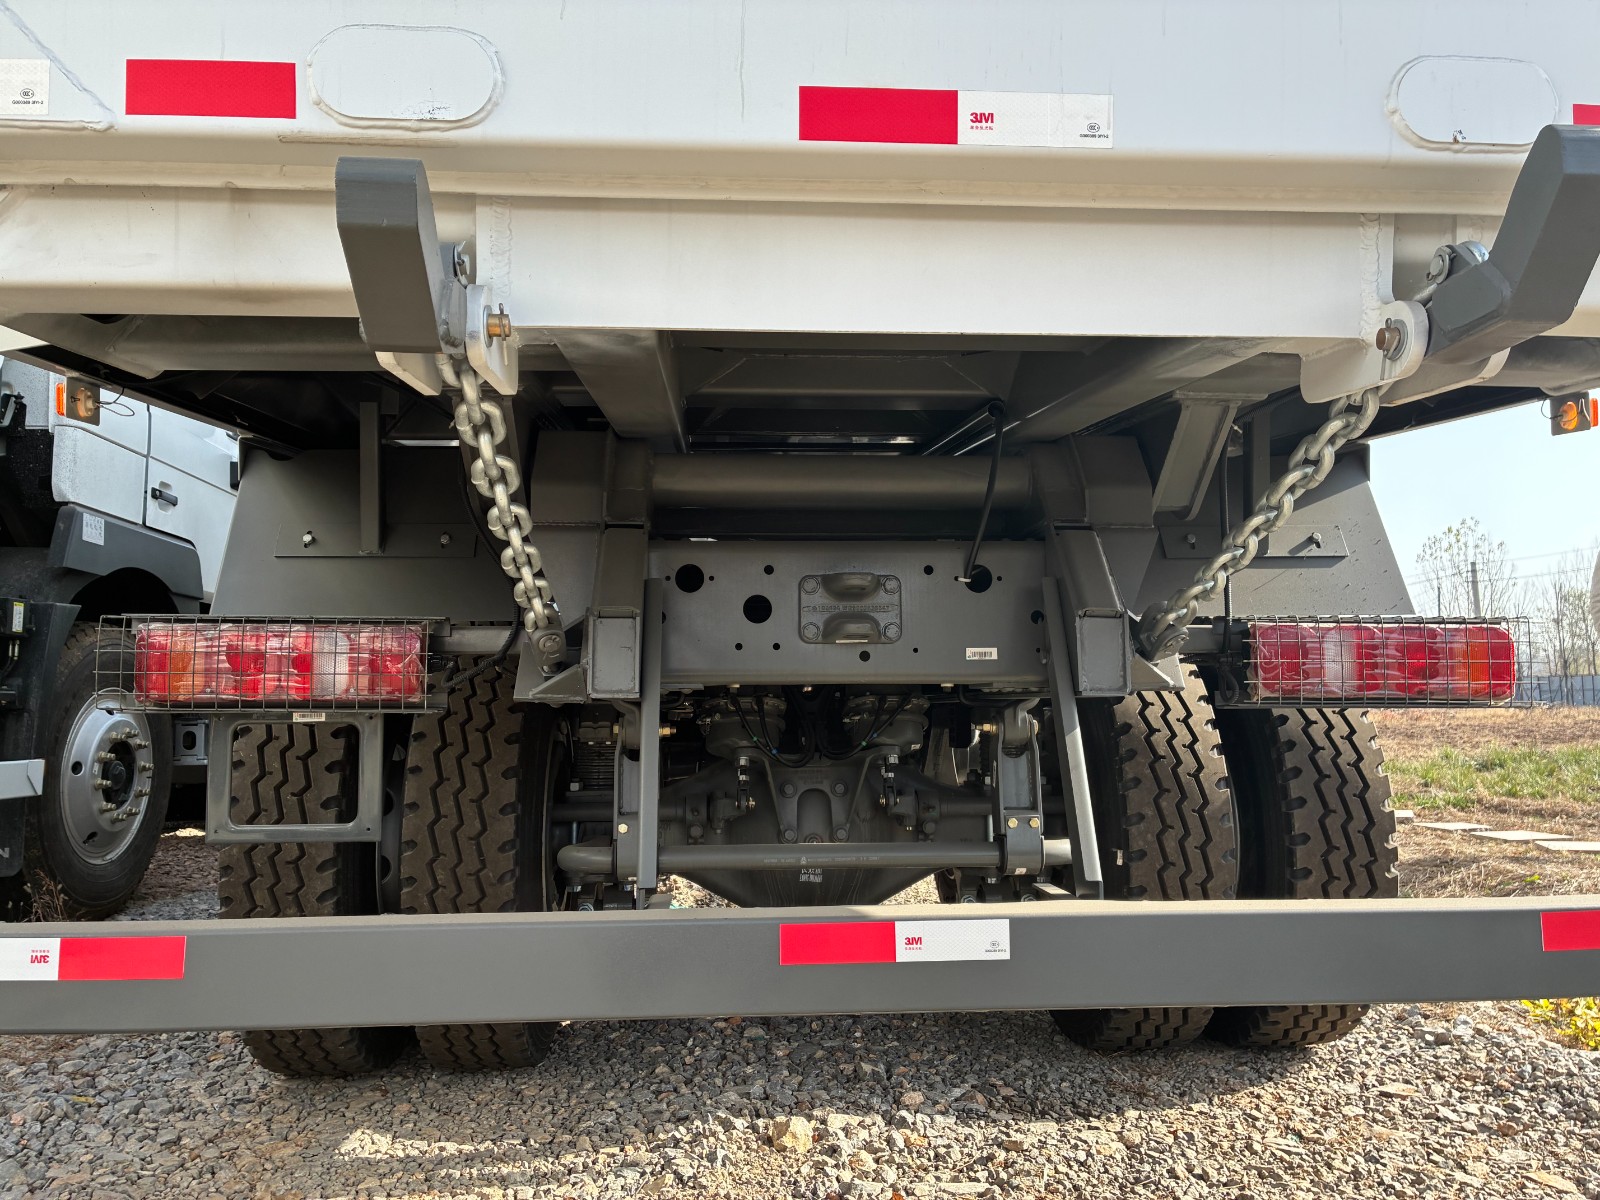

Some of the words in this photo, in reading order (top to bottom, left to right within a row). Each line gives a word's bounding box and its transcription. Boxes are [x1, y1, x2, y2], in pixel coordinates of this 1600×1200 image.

[970, 112, 994, 123] 3M
[905, 936, 922, 946] 3M
[30, 954, 49, 964] 3M
